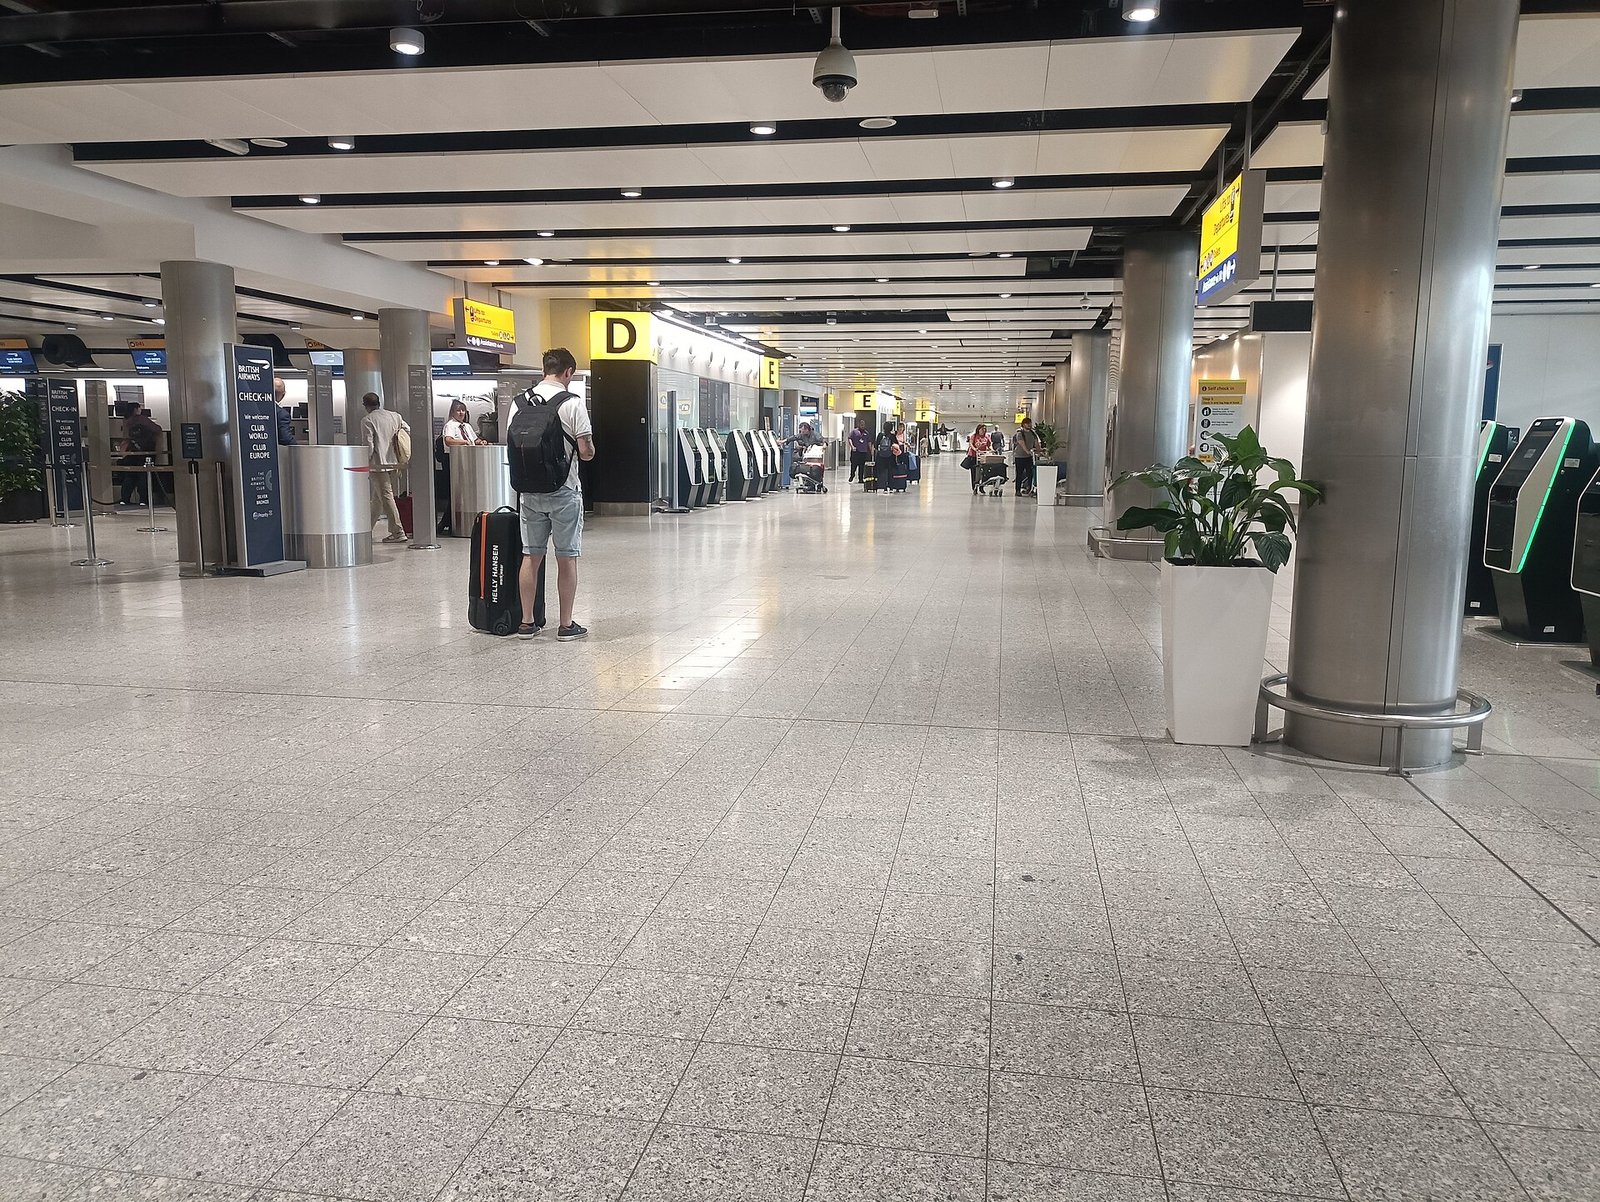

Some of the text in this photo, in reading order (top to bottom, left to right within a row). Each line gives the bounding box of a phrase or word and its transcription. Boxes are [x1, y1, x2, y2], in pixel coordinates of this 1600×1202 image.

[606, 317, 637, 354] D
[238, 365, 260, 374] BRITISH
[768, 361, 775, 385] E
[237, 373, 261, 381] AIRWAYS
[238, 391, 273, 402] CHECK-IN
[863, 394, 872, 408] E
[921, 411, 926, 420] F
[250, 424, 265, 432] CLUB
[248, 432, 269, 440] WORLD
[252, 443, 267, 451] CLUB
[249, 452, 271, 460] EUROPE
